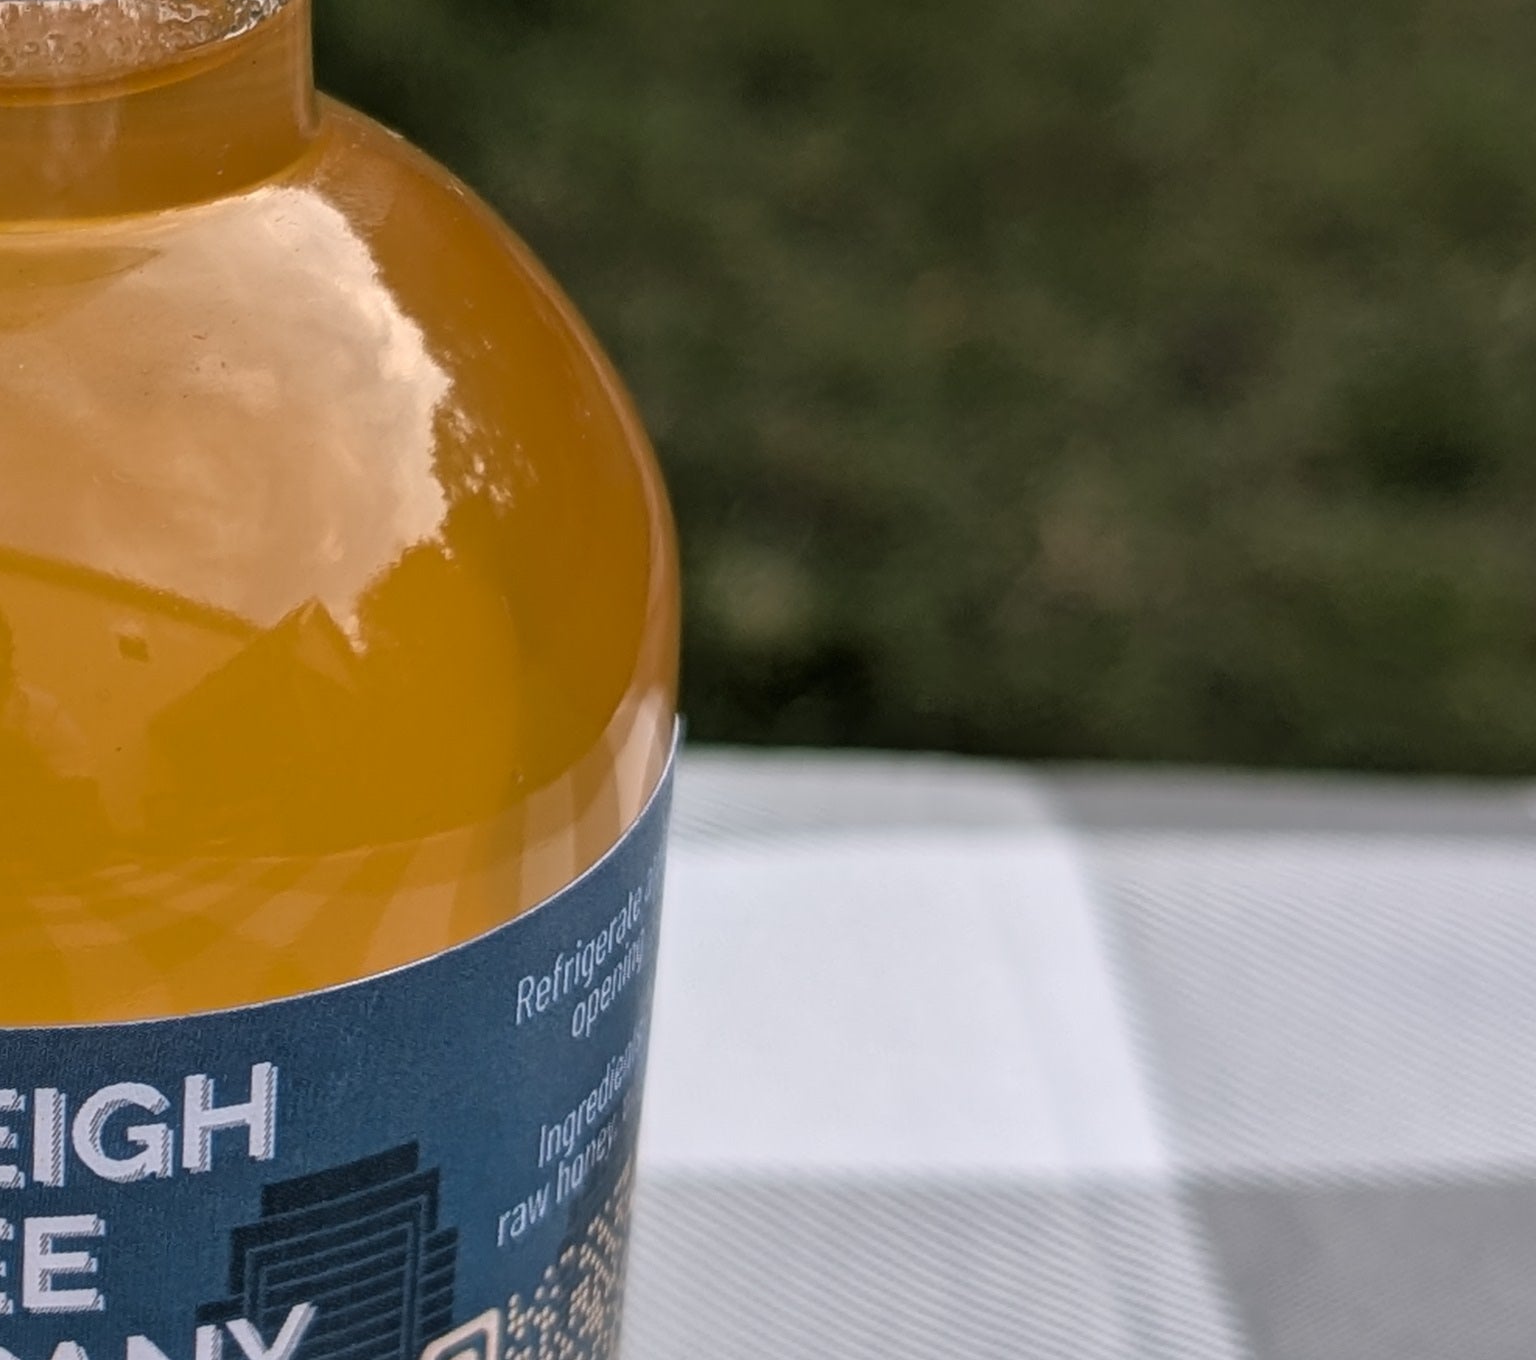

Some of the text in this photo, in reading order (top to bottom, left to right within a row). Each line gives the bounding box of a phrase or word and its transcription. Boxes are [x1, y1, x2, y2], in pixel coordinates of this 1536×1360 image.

[516, 887, 643, 1026] Refrigerate
[572, 927, 646, 1038] opening
[497, 1181, 551, 1248] raw
